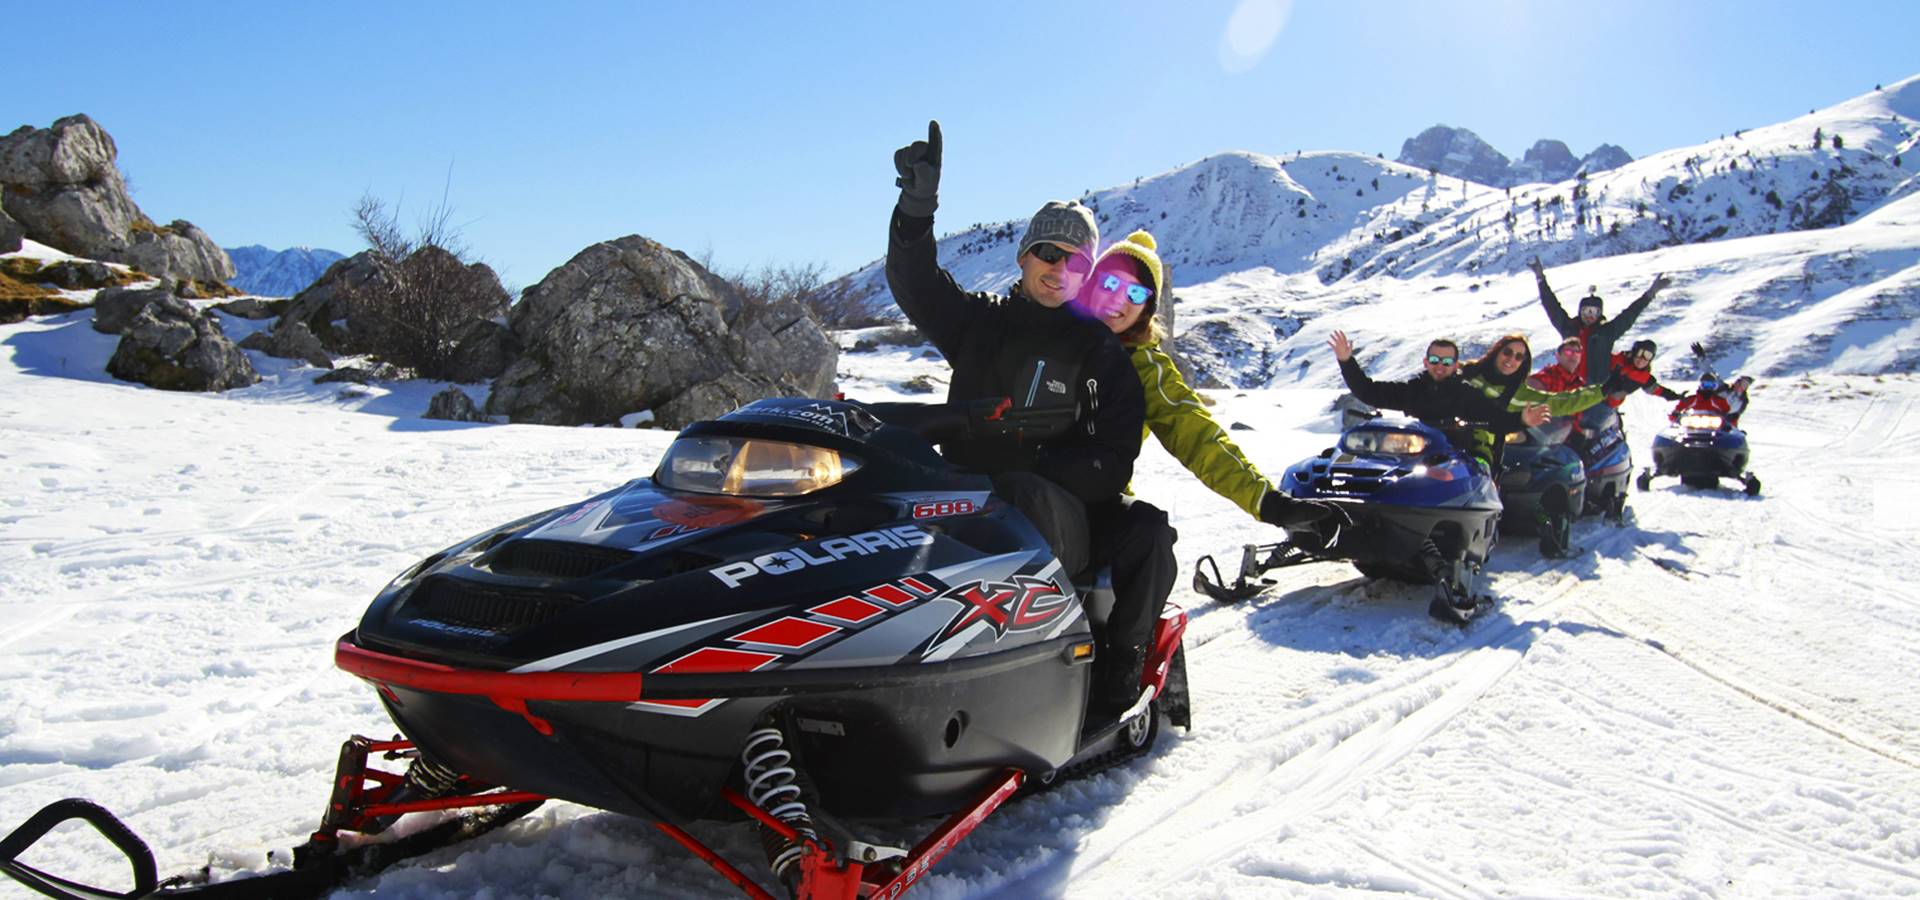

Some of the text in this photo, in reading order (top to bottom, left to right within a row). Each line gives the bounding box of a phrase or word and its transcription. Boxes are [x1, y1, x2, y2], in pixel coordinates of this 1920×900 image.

[913, 500, 975, 519] 600
[709, 525, 934, 589] POLARIS
[927, 576, 1073, 650] XC
